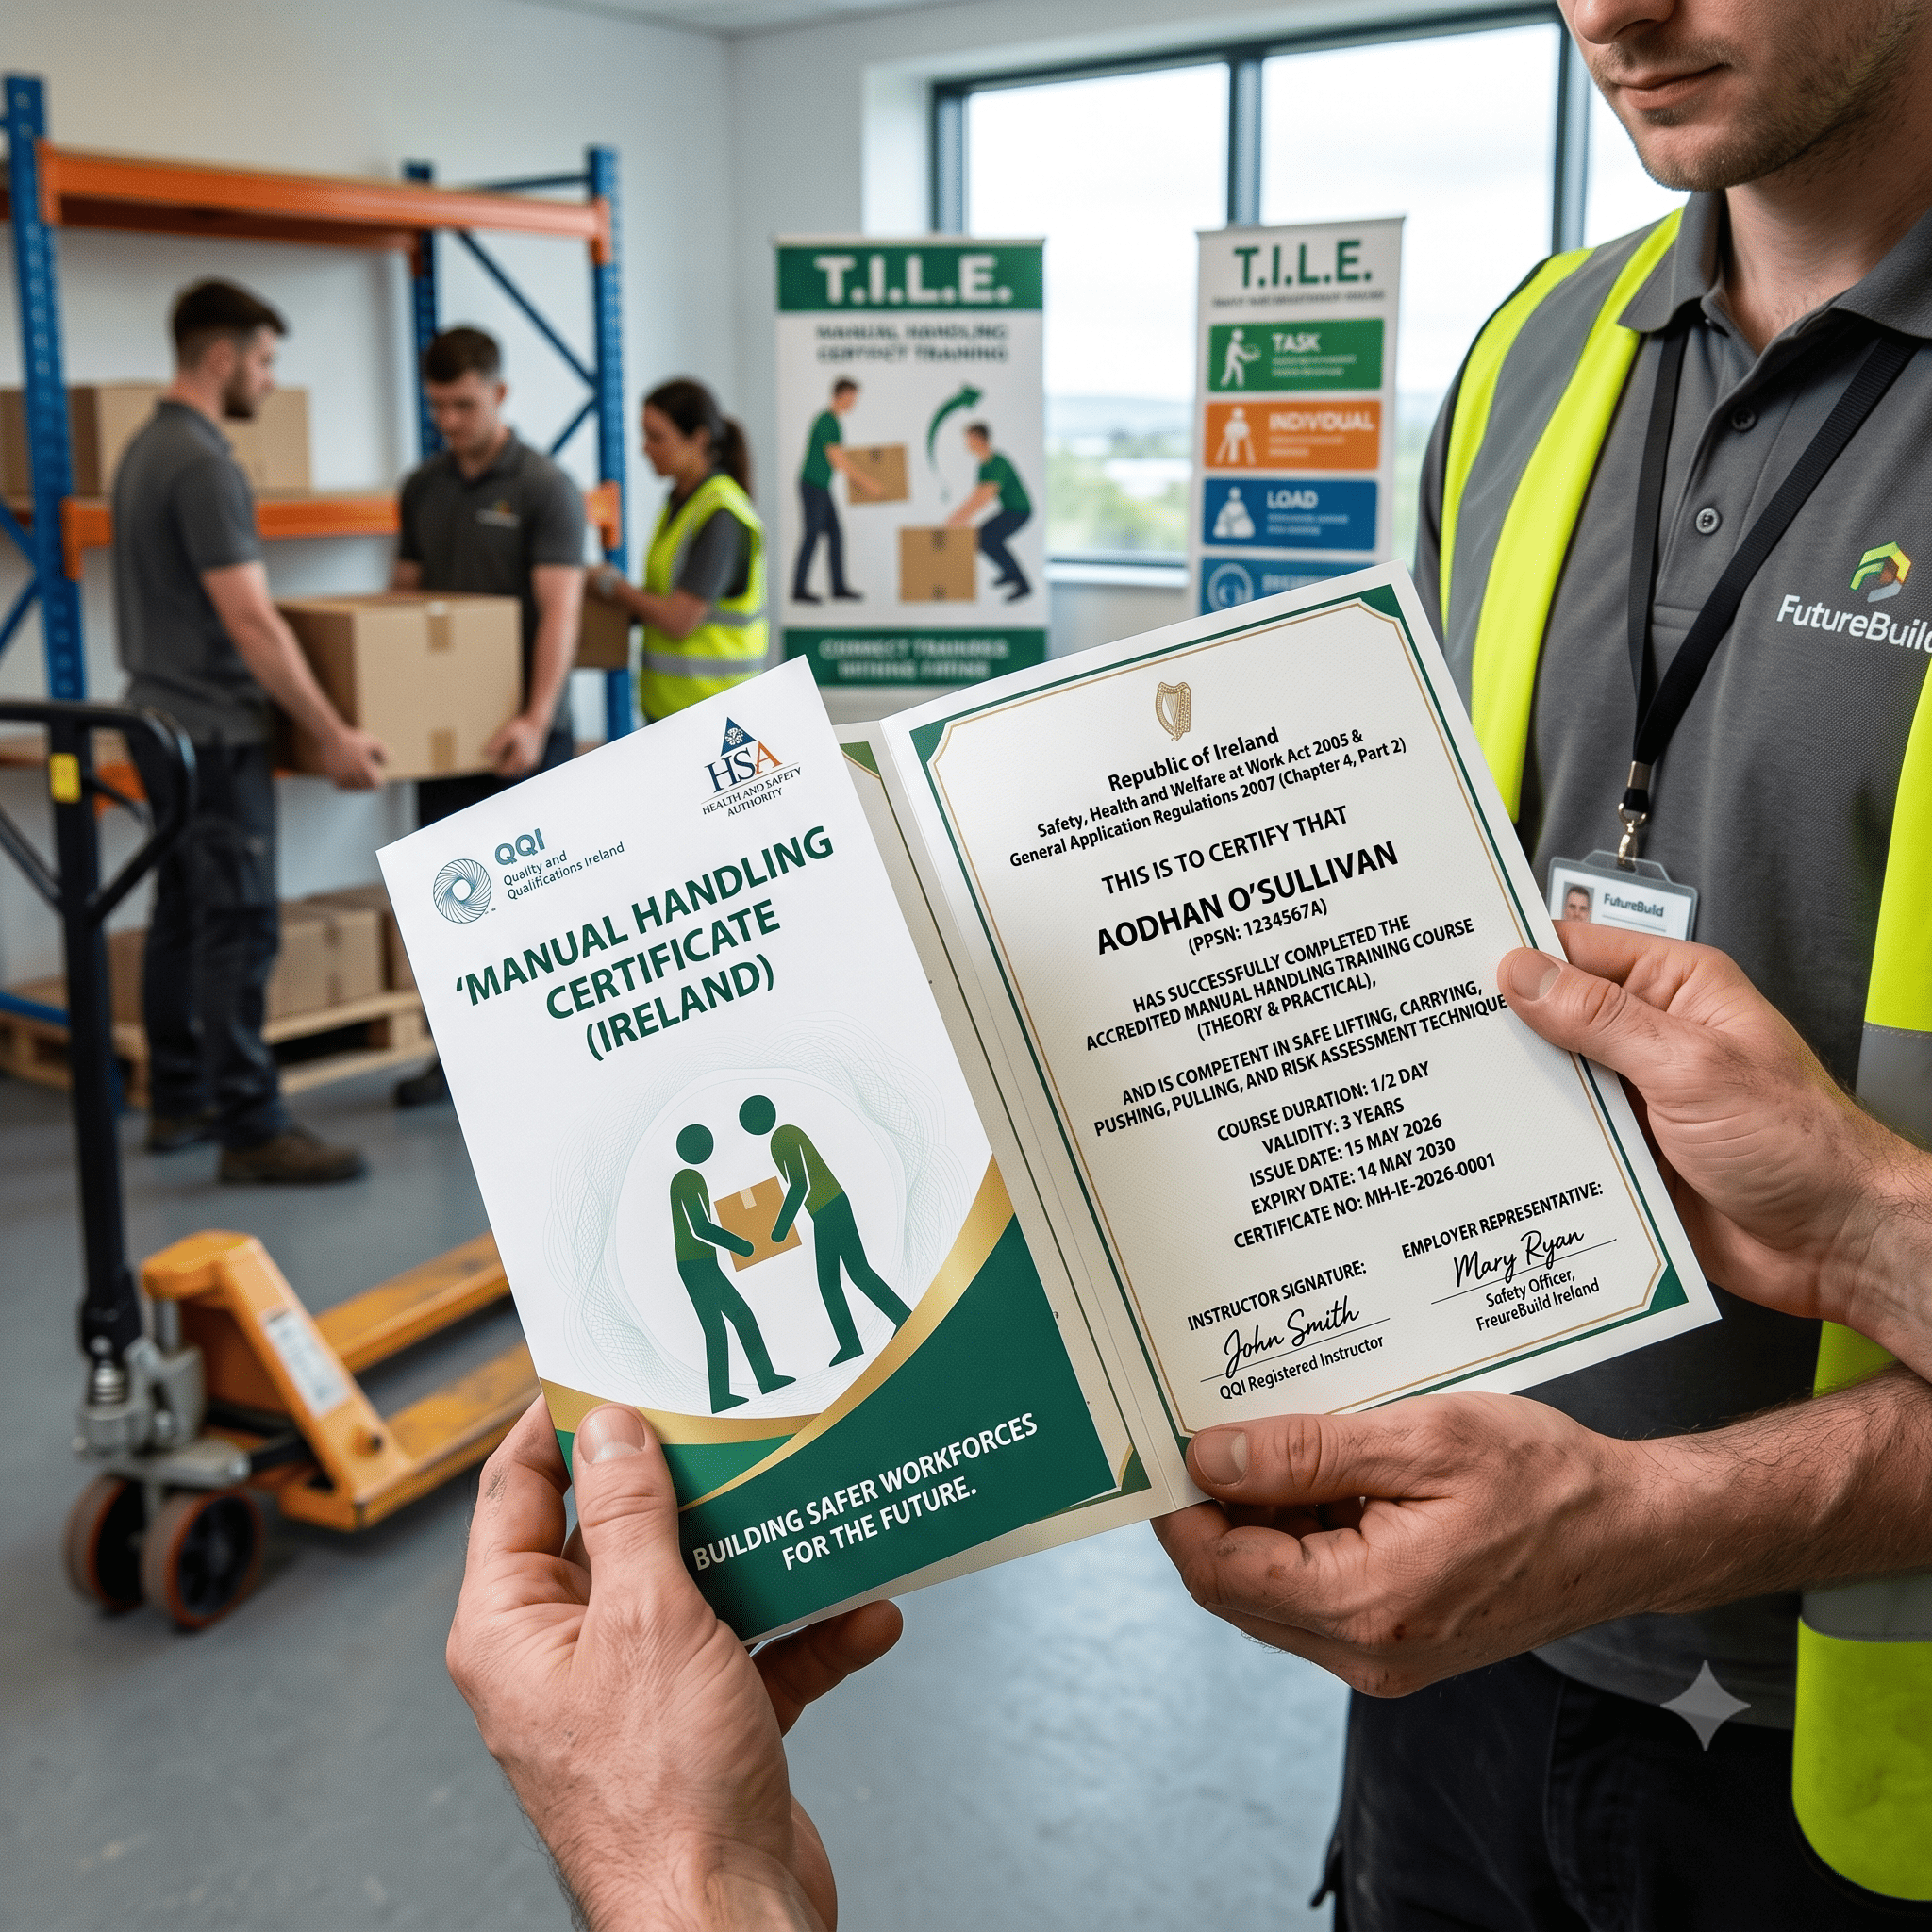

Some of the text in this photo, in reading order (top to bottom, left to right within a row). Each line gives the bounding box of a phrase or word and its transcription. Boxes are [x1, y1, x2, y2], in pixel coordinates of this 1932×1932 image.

[814, 254, 1013, 305] T.I.L.E.
[1234, 240, 1373, 289] T.I.L.E.
[1272, 332, 1322, 353] TASK
[1269, 411, 1375, 432] INDIVIDUAL
[1266, 489, 1319, 509] LOAD
[702, 767, 800, 815] HEALTH AND SAFETY
[704, 741, 783, 793] HSA
[1037, 729, 1364, 838] Safety, Health and Welfare at Work Act 2005 &
[1108, 726, 1279, 791] Republic of Ireland
[728, 788, 781, 816] AUTHORITY
[1010, 737, 1407, 867] General Application Regulations 2007 (Chapter 4, Part 2)
[495, 828, 545, 865] QQI
[504, 850, 567, 886] Quality and
[508, 841, 625, 900] Qualifications Ireland
[631, 825, 834, 935] HANDLING
[1101, 805, 1346, 894] THIS IS TO CERTIFY THAT
[1098, 893, 1224, 955] AODHAN
[1189, 898, 1327, 956] (PPSN: 1234567A)
[1604, 893, 1664, 917] FutureBuild
[546, 898, 780, 1019] CERTIFICATE
[1087, 918, 1474, 1051] ACCREDITED MANUAL HANDLING TRAINING COURSE
[1132, 914, 1411, 1013] HAS SUCCESSFULLY COMPLETED THE
[587, 954, 774, 1061] (IRELAND)
[1197, 972, 1376, 1041] (THEORY & PRACTICAL),
[1123, 980, 1482, 1106] AND IS COMPETENT IN SAFE LIFTING, CARRYING,
[1093, 1102, 1166, 1137] PUSHING,
[1171, 1078, 1243, 1112] PULLING,
[1246, 1066, 1279, 1090] AND
[1281, 1053, 1319, 1077] RISK
[1321, 1021, 1417, 1066] ASSESSMENT
[1217, 1060, 1428, 1141] COURSE DURATION: 1/2 DAY
[1249, 1113, 1442, 1187] ISSUE DATE: 15 MAY 2026
[1261, 1097, 1405, 1154] VALIDITY: 3 YEARS
[1234, 1153, 1495, 1248] CERTIFICATE NO: MH-IE-2026-0001
[1251, 1137, 1456, 1215] EXPIRY DATE: 14 MAY 2030
[1401, 1181, 1603, 1259] EMPLOYER REPRESENTATIVE:
[1454, 1229, 1585, 1288] Mary Ryan
[1486, 1271, 1575, 1307] Safety Officer,
[1188, 1260, 1367, 1331] INSTRUCTOR SIGNATURE:
[1475, 1277, 1599, 1331] FreureBuild Ireland
[1220, 1336, 1383, 1400] QQI Registered Instructor
[1224, 1295, 1360, 1379] John Smith
[693, 1413, 1037, 1570] BUILDING SAFER WORKFORCES
[782, 1475, 976, 1571] FOR THE FUTURE.
